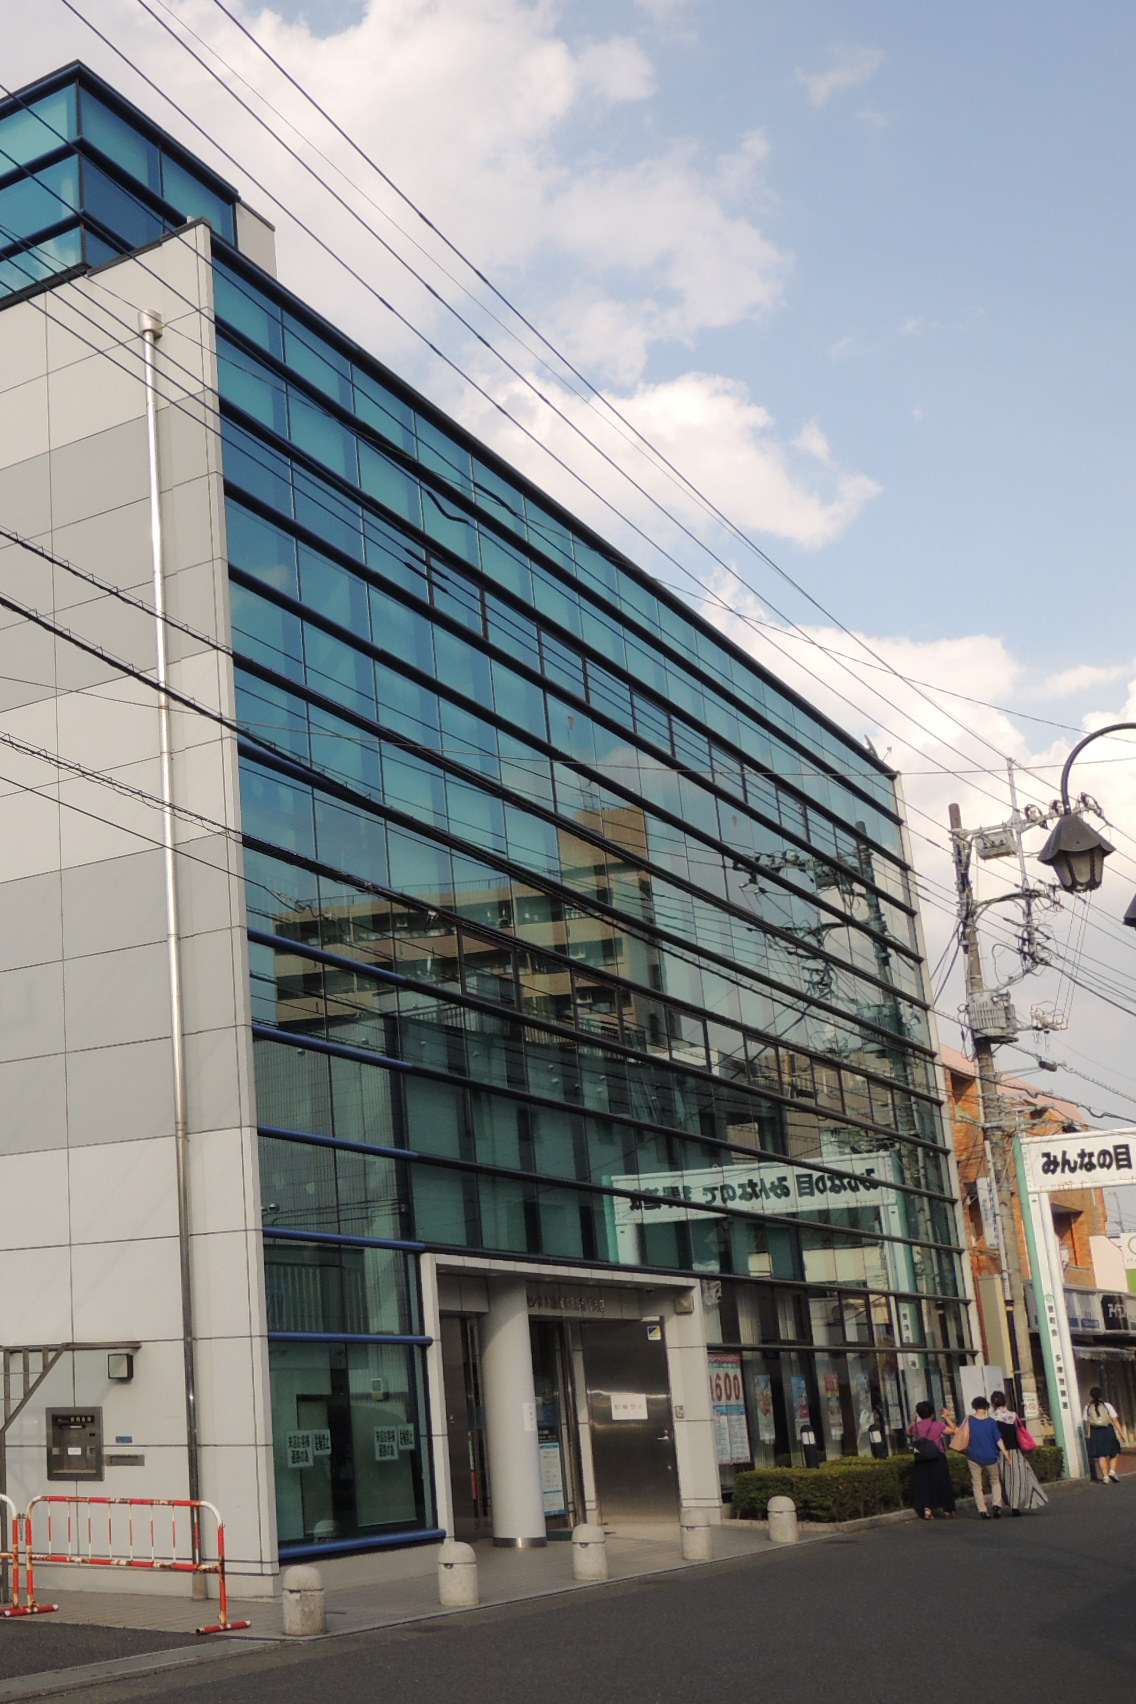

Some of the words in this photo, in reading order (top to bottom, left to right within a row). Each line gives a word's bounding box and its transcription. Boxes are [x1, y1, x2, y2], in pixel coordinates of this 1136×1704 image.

[1041, 1144, 1132, 1175] みんなの目
